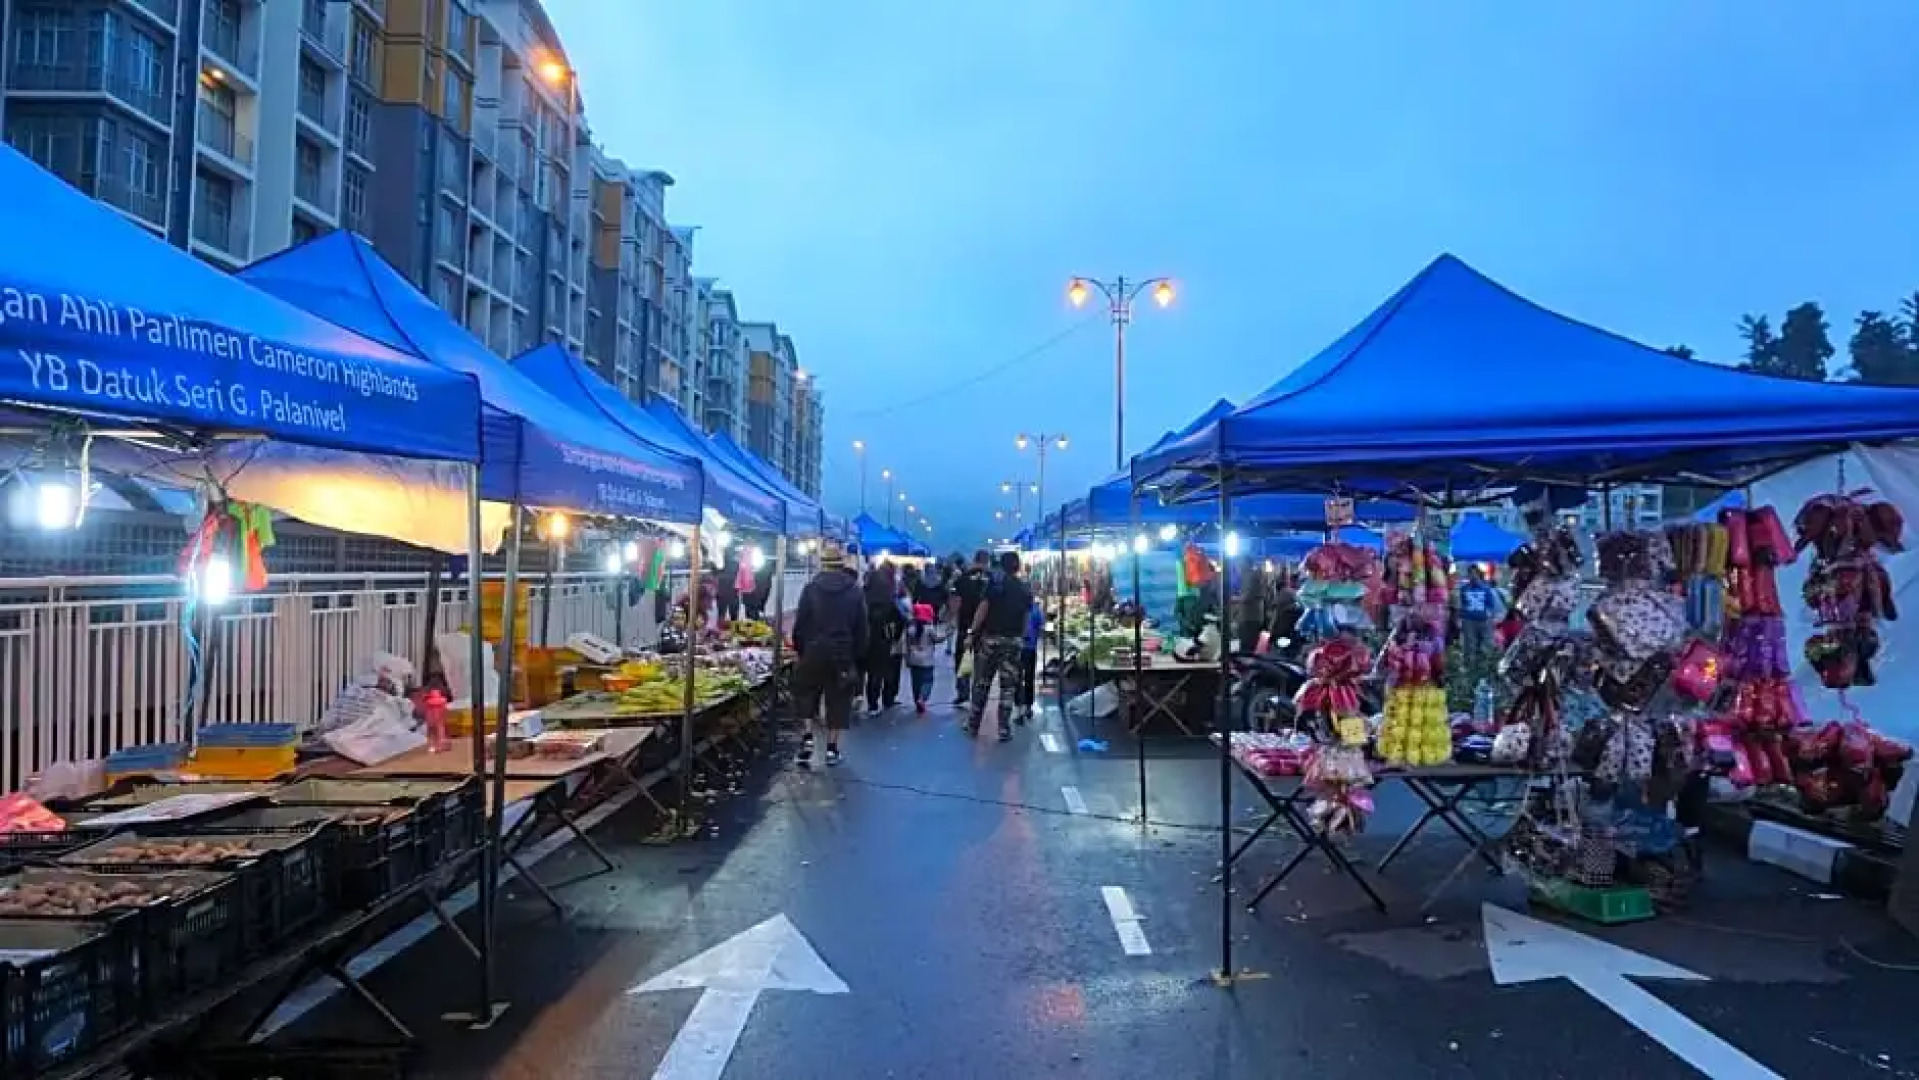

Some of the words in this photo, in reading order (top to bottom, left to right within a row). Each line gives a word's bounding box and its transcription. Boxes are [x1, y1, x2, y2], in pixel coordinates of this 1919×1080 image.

[0, 286, 48, 325] an
[60, 293, 120, 337] Ahli
[127, 306, 243, 360] Parlimen
[249, 335, 340, 384] Cameron
[341, 357, 420, 402] Highlands
[18, 348, 69, 391] YB
[77, 358, 172, 406] Datuk
[174, 375, 225, 412] Seri
[229, 383, 257, 417] G.
[261, 388, 347, 433] Palanivel
